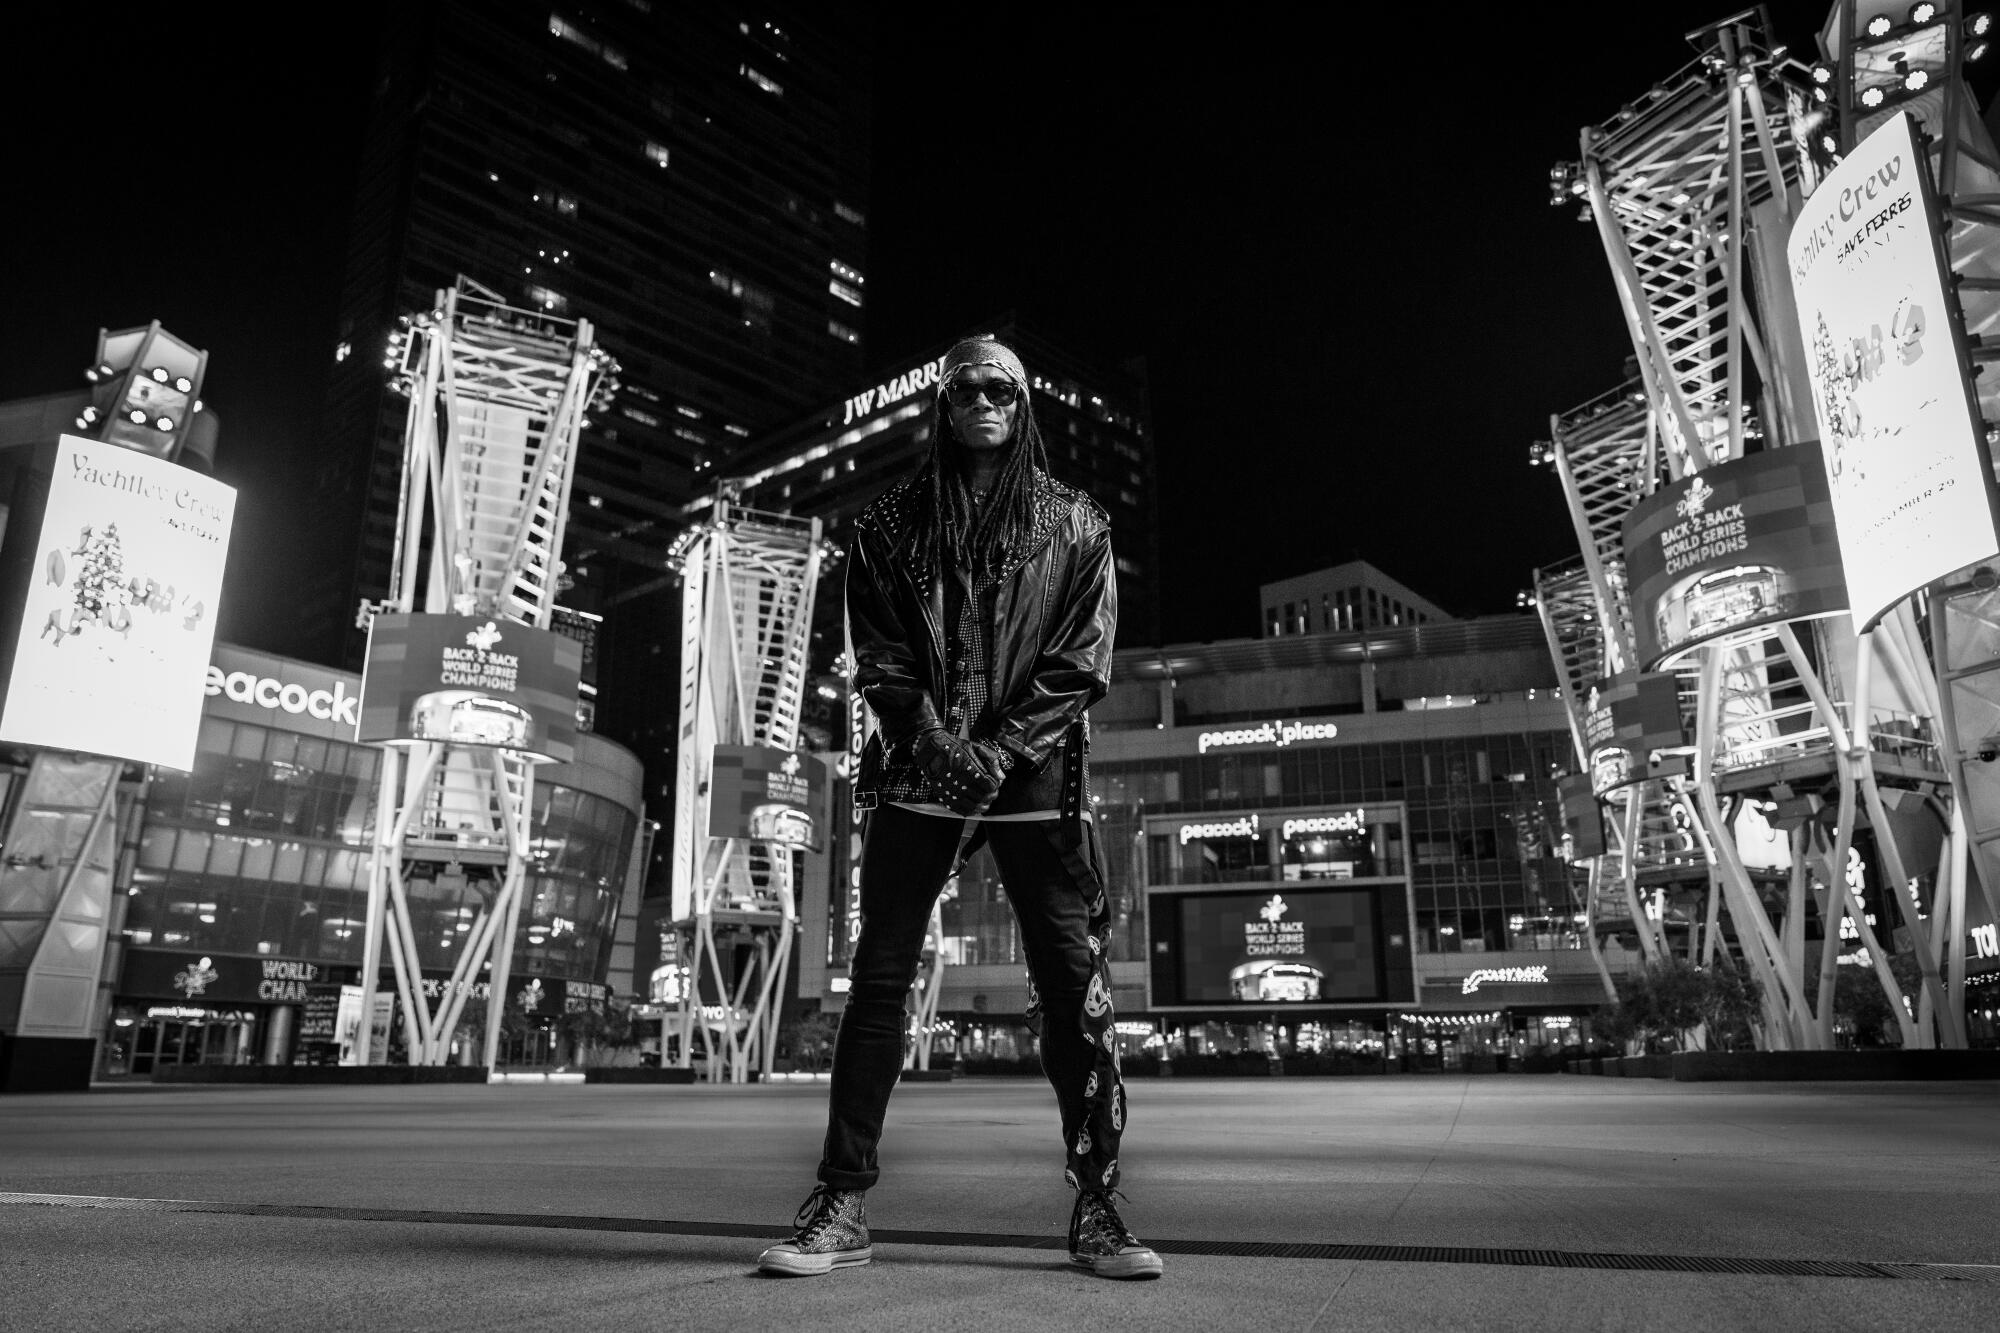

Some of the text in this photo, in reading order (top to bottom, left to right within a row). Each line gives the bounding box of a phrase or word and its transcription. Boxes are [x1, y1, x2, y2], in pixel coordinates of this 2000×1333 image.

[1839, 155, 1901, 222] Crew
[1836, 228, 1864, 264] SAVE
[843, 355, 946, 425] JW MARRI
[1938, 478, 1955, 492] 29
[175, 488, 225, 522] Crew
[1661, 504, 1744, 547] BACK-2-BACK
[1663, 520, 1746, 560] WORLD SERIES
[1666, 534, 1748, 576] CHAMPIONS
[442, 660, 517, 679] WORLD SERIES
[443, 647, 519, 668] BACK-2-BACK
[205, 665, 358, 725] eacock
[440, 672, 516, 692] CHAMPIONS
[1246, 933, 1304, 944] WORLD SERIES
[1247, 943, 1305, 956] CHAMPIONS
